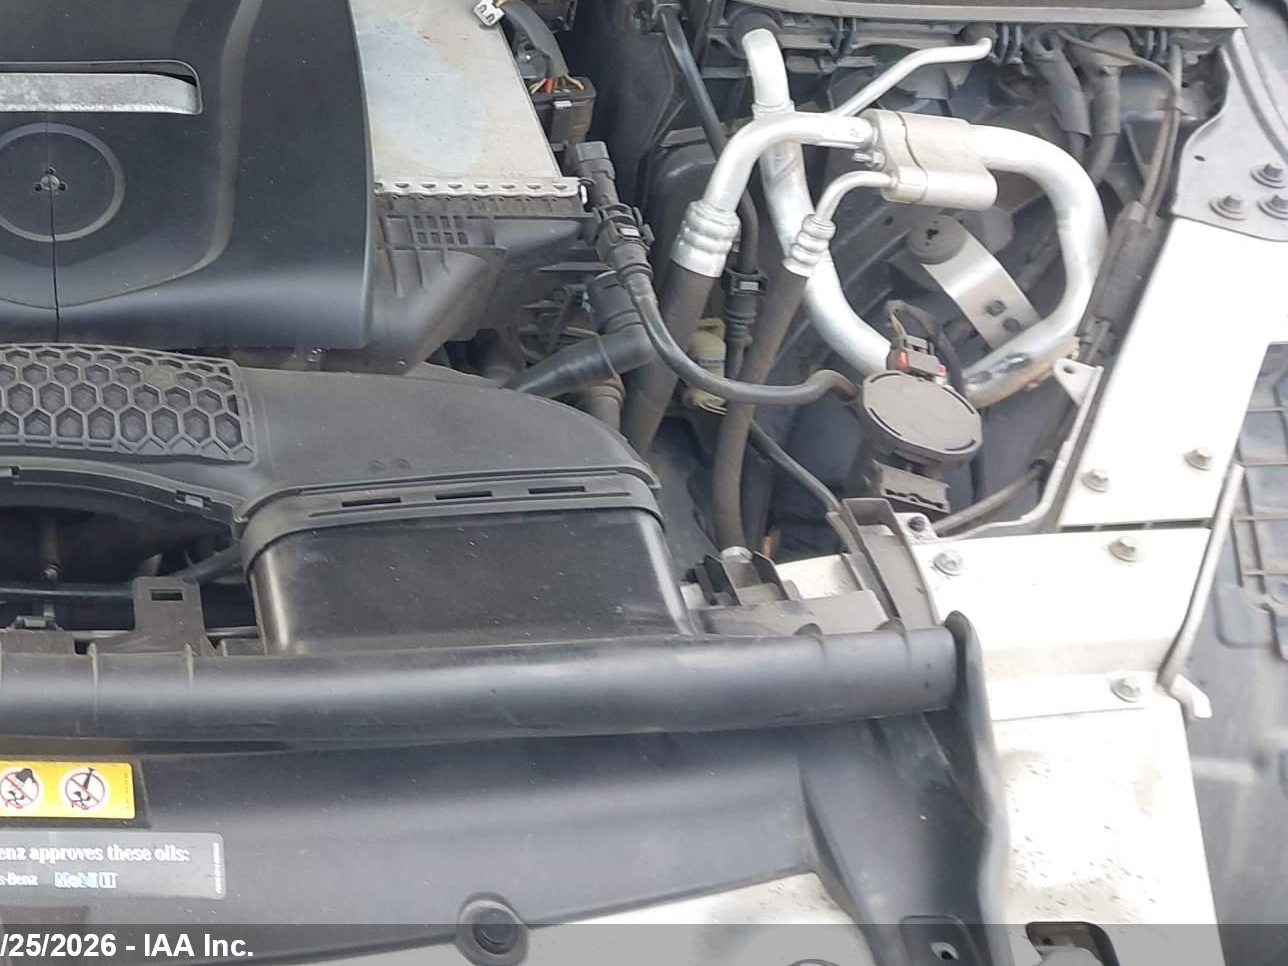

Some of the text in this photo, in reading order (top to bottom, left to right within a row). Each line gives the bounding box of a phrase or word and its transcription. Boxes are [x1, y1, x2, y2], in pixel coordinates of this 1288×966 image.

[29, 847, 104, 864] approves
[107, 844, 152, 861] these
[155, 844, 191, 862] oils:
